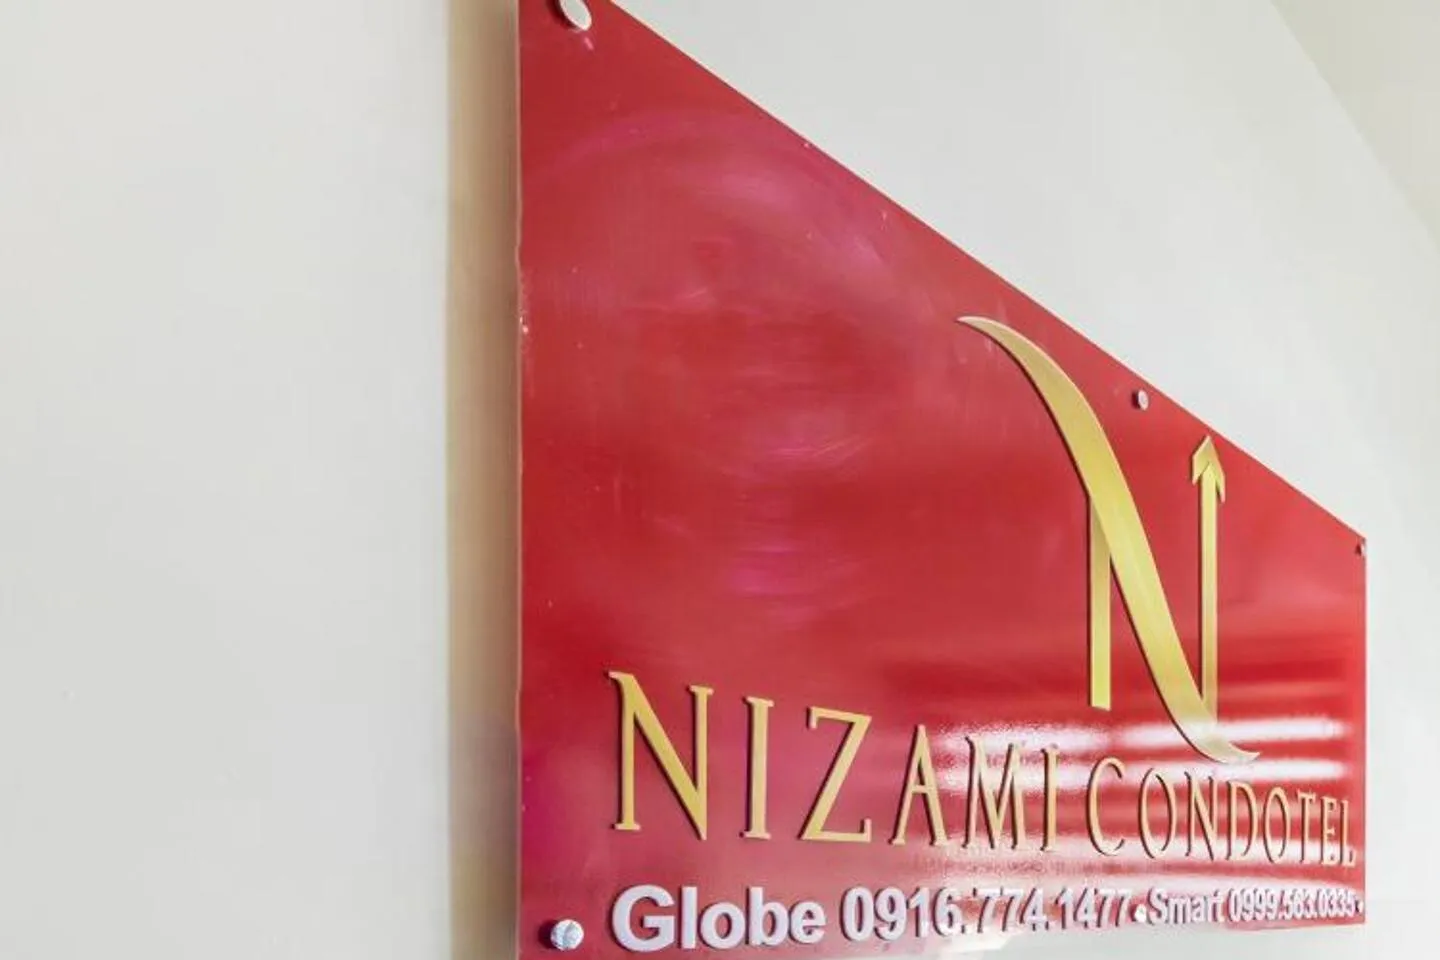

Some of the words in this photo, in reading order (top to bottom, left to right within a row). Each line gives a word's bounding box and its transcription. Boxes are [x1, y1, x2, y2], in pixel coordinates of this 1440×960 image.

[606, 671, 1060, 852] NIZAMI
[1086, 756, 1356, 868] CONDOTEL
[610, 884, 827, 952] Globe
[840, 885, 1132, 942] 0916.774.1477
[1148, 887, 1225, 925] Smart
